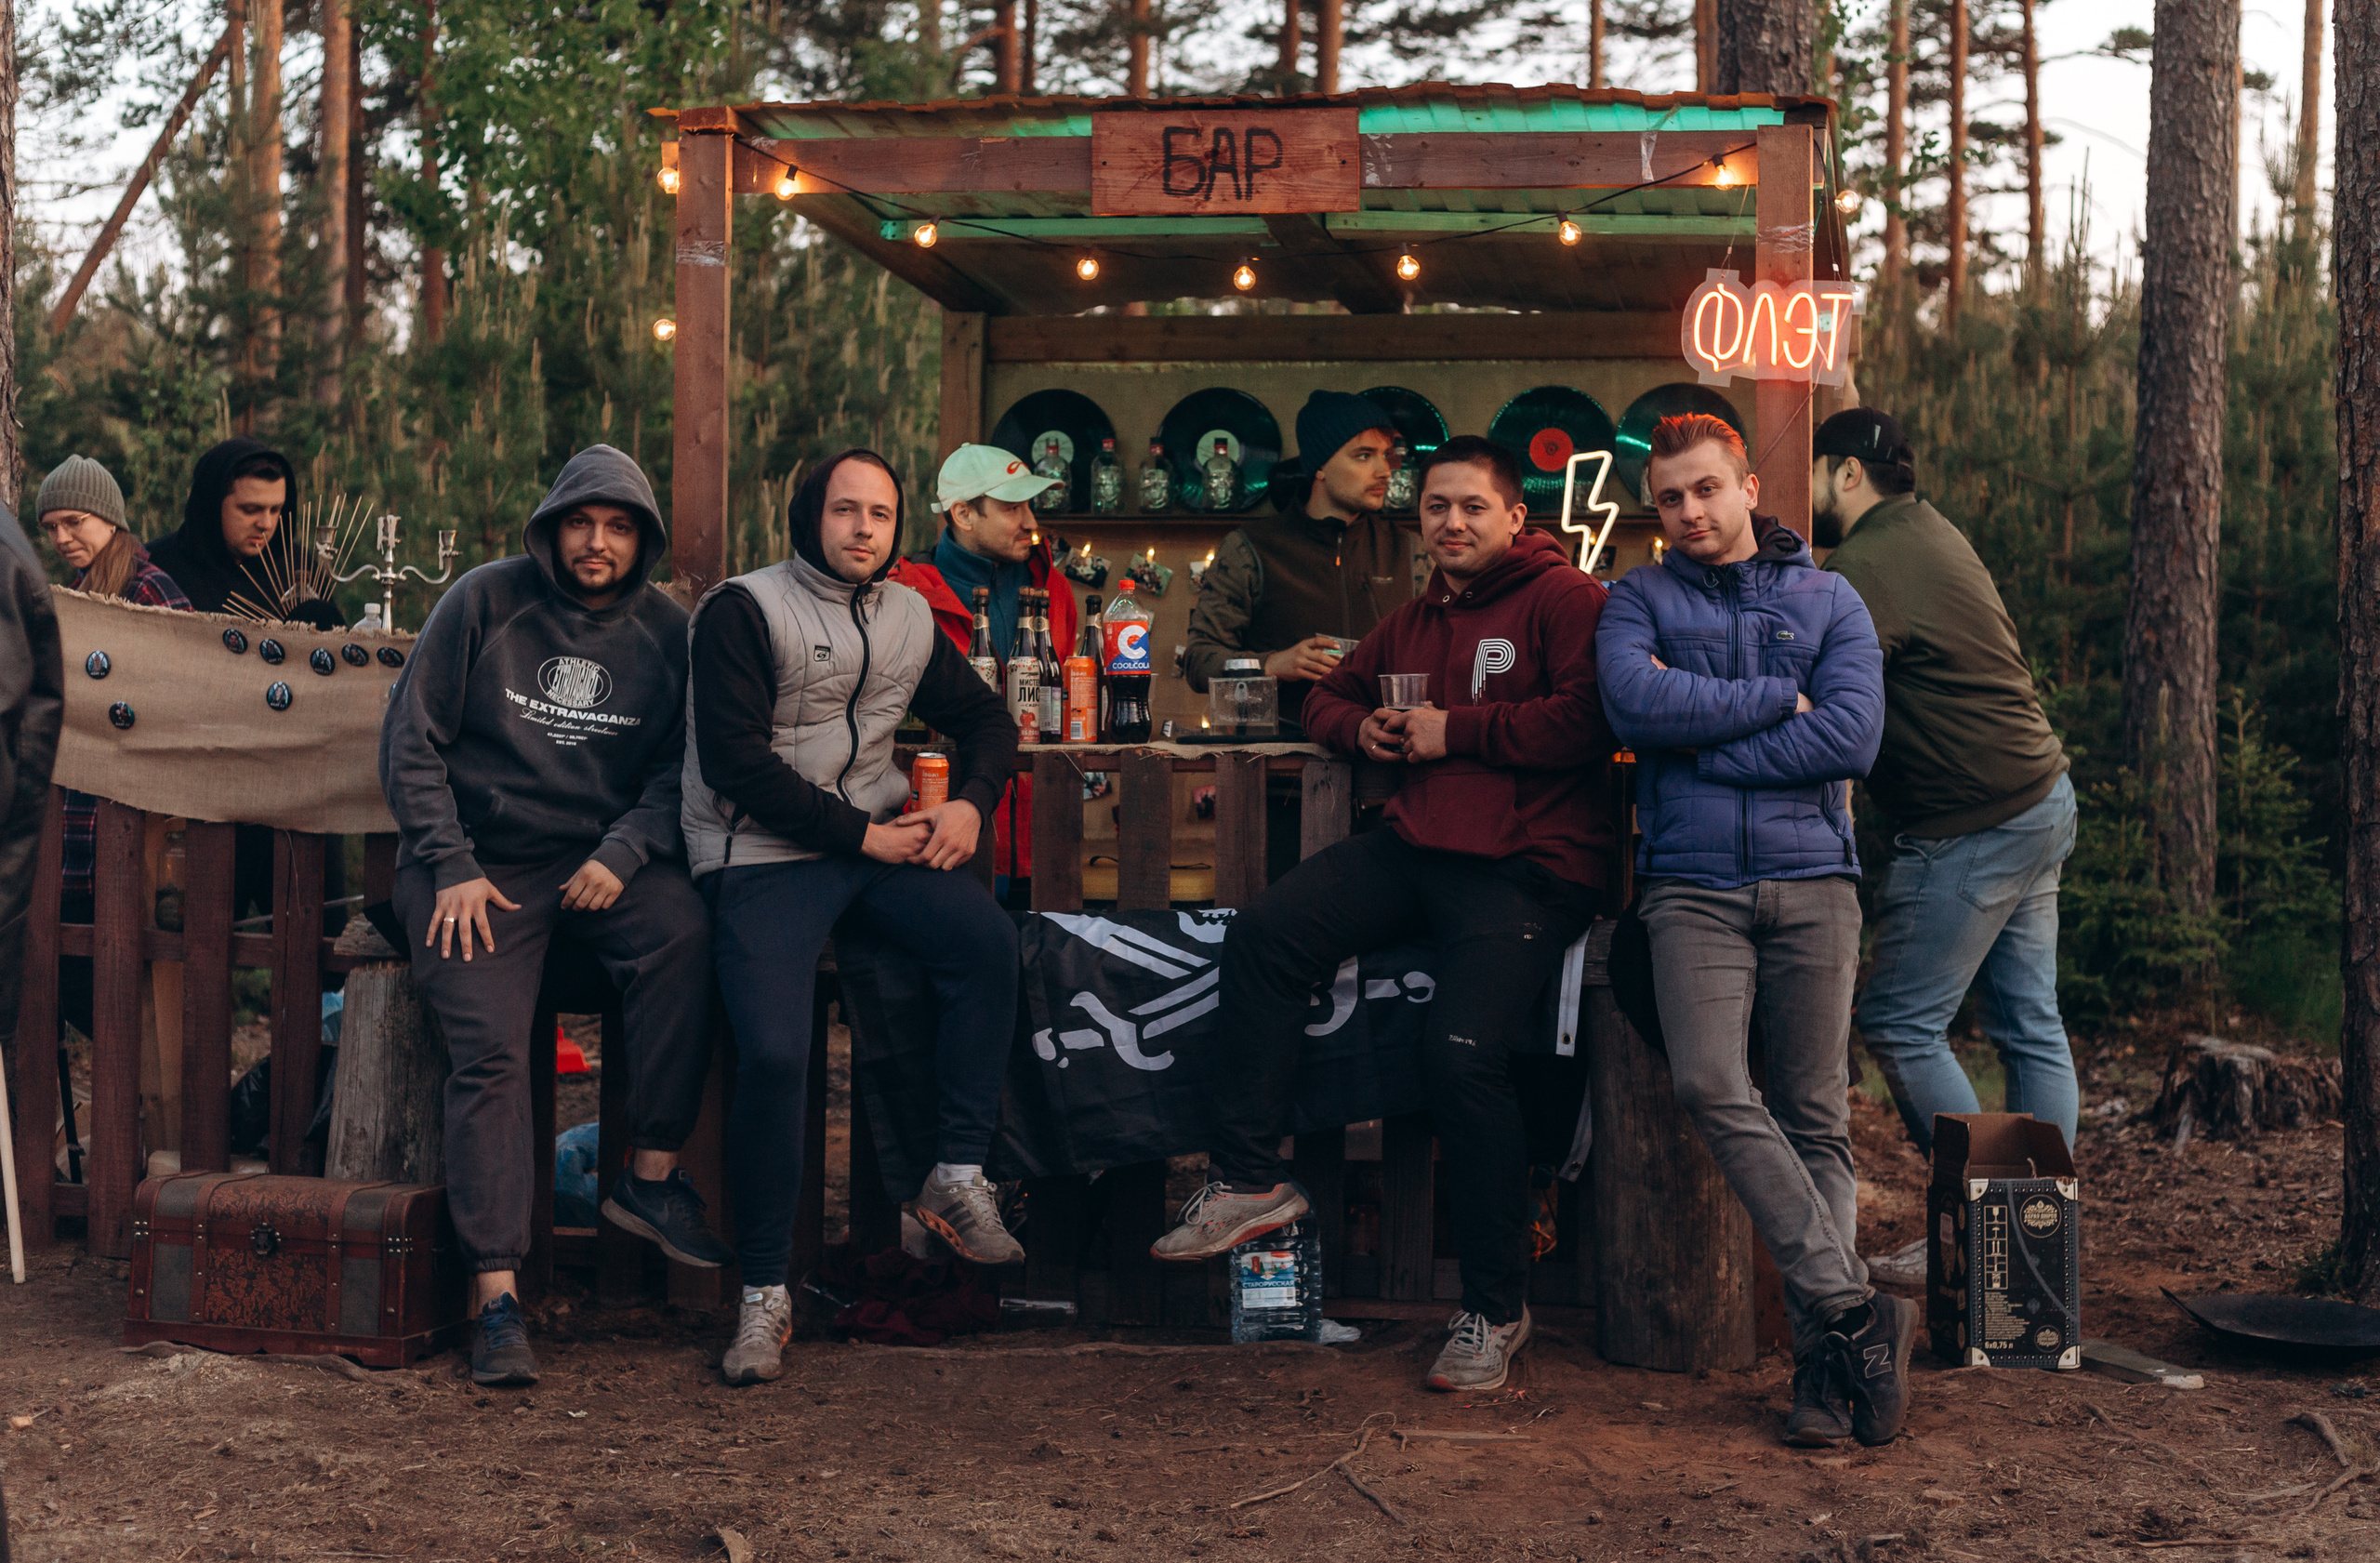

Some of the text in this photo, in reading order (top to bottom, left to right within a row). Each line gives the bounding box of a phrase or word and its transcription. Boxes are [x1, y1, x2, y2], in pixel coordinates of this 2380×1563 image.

[1163, 126, 1283, 201] БАР
[1694, 283, 1853, 373] ФЛЭТ
[559, 657, 601, 673] ATHLETIC
[1472, 638, 1515, 707] P
[505, 688, 527, 707] THE
[547, 689, 594, 707] NECESSARY
[520, 708, 553, 726] Limited
[553, 720, 582, 730] edition
